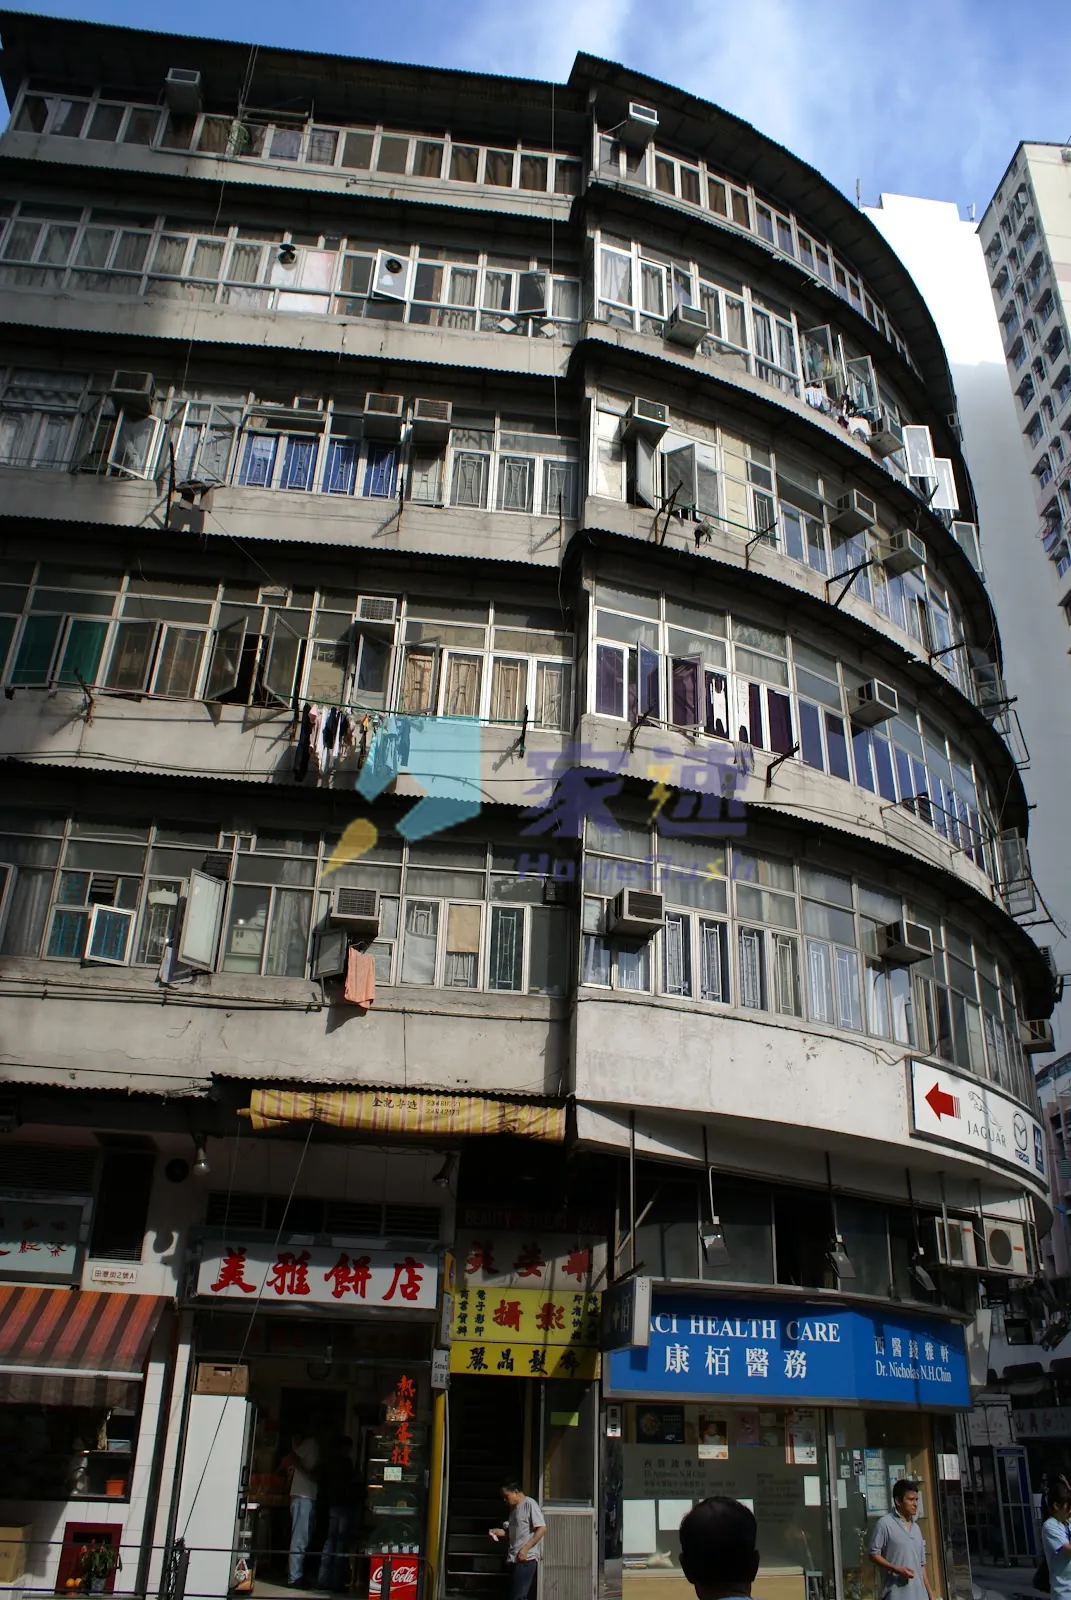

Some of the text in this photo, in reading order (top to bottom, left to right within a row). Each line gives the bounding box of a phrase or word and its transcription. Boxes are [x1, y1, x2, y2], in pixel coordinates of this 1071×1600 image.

[967, 1120, 1007, 1148] JAGUAR
[210, 1246, 424, 1301] 美雅餅店
[492, 1299, 567, 1332] 攝影
[689, 1314, 777, 1340] HEALTH
[786, 1320, 841, 1343] CARE
[664, 1343, 808, 1379] 康栢醫務
[875, 1360, 888, 1377] Dr.
[888, 1361, 920, 1380] Nicholas
